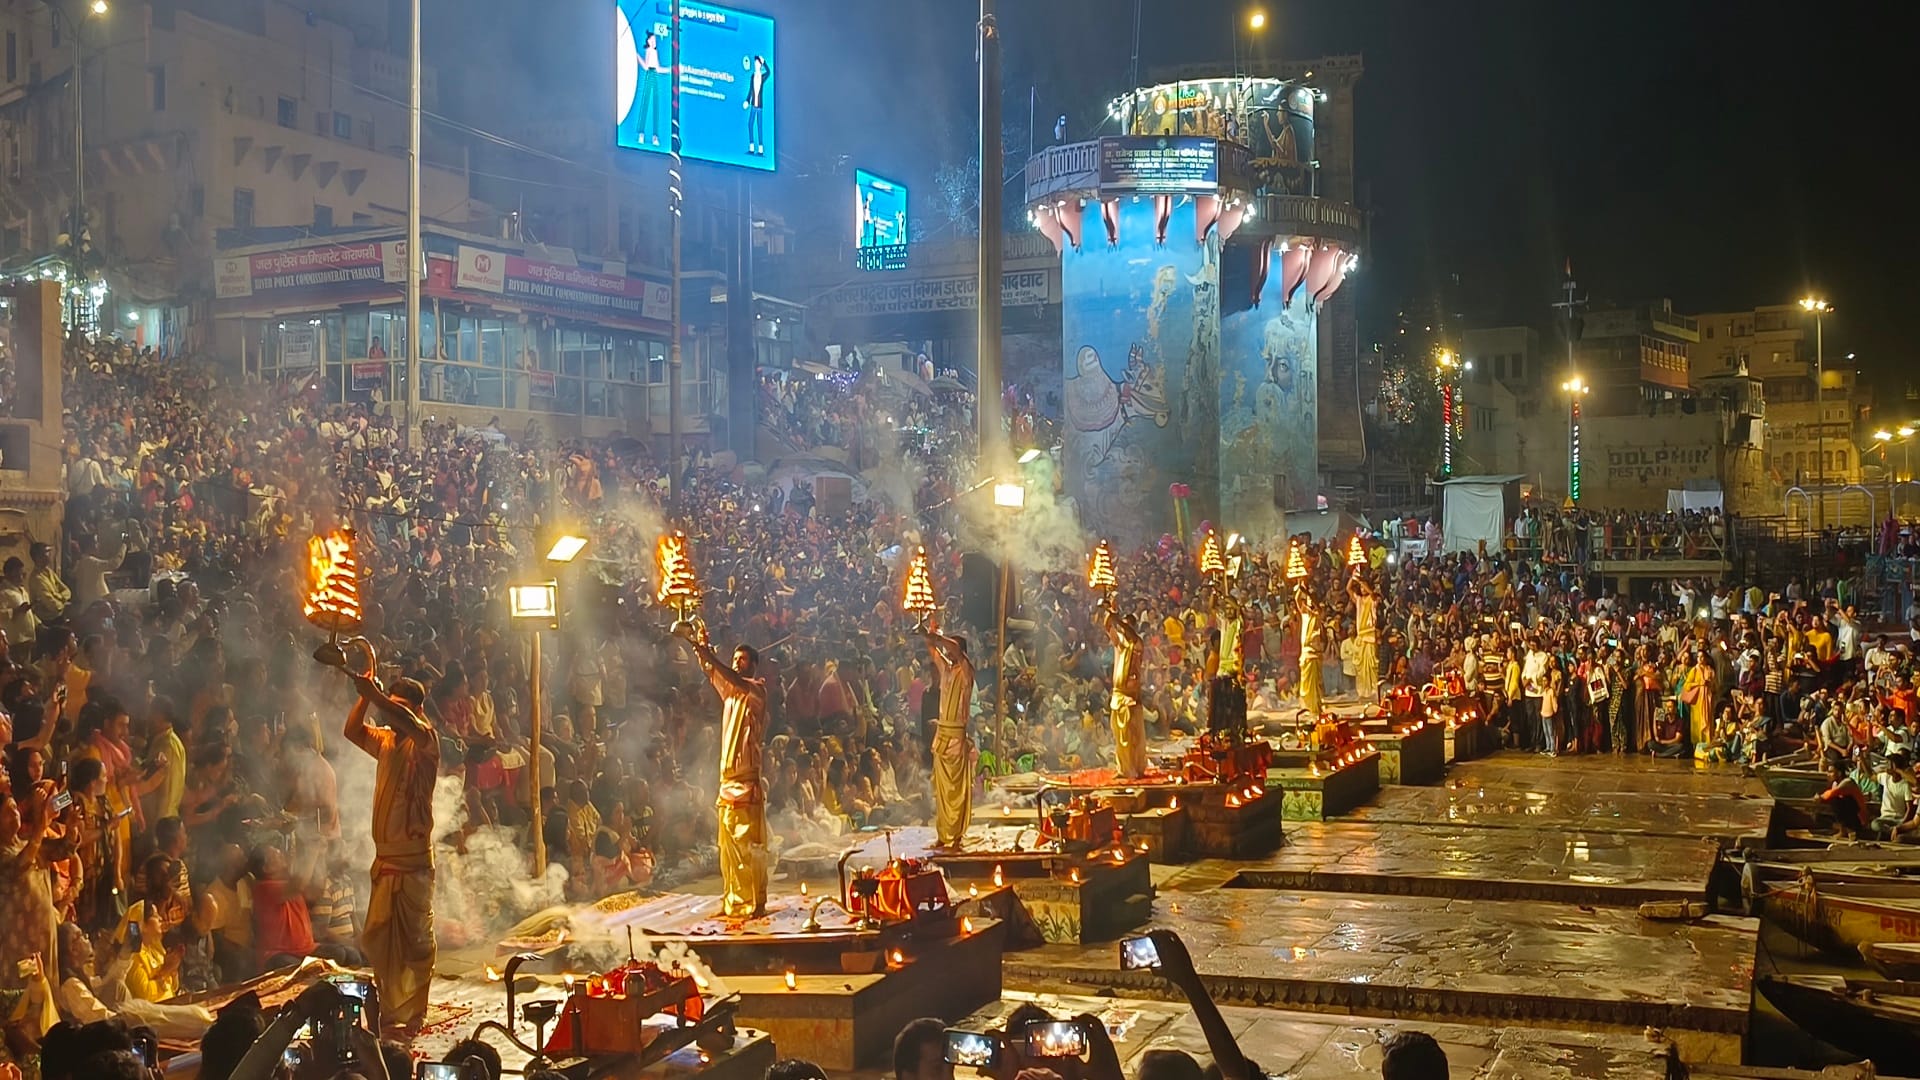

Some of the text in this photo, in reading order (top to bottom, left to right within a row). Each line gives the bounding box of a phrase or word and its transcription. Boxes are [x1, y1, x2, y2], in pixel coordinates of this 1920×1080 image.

[274, 275, 295, 288] POLICE
[351, 267, 381, 280] VARANASI
[1019, 272, 1044, 288] घाट
[508, 279, 530, 293] RIVER
[531, 282, 553, 297] POLICE
